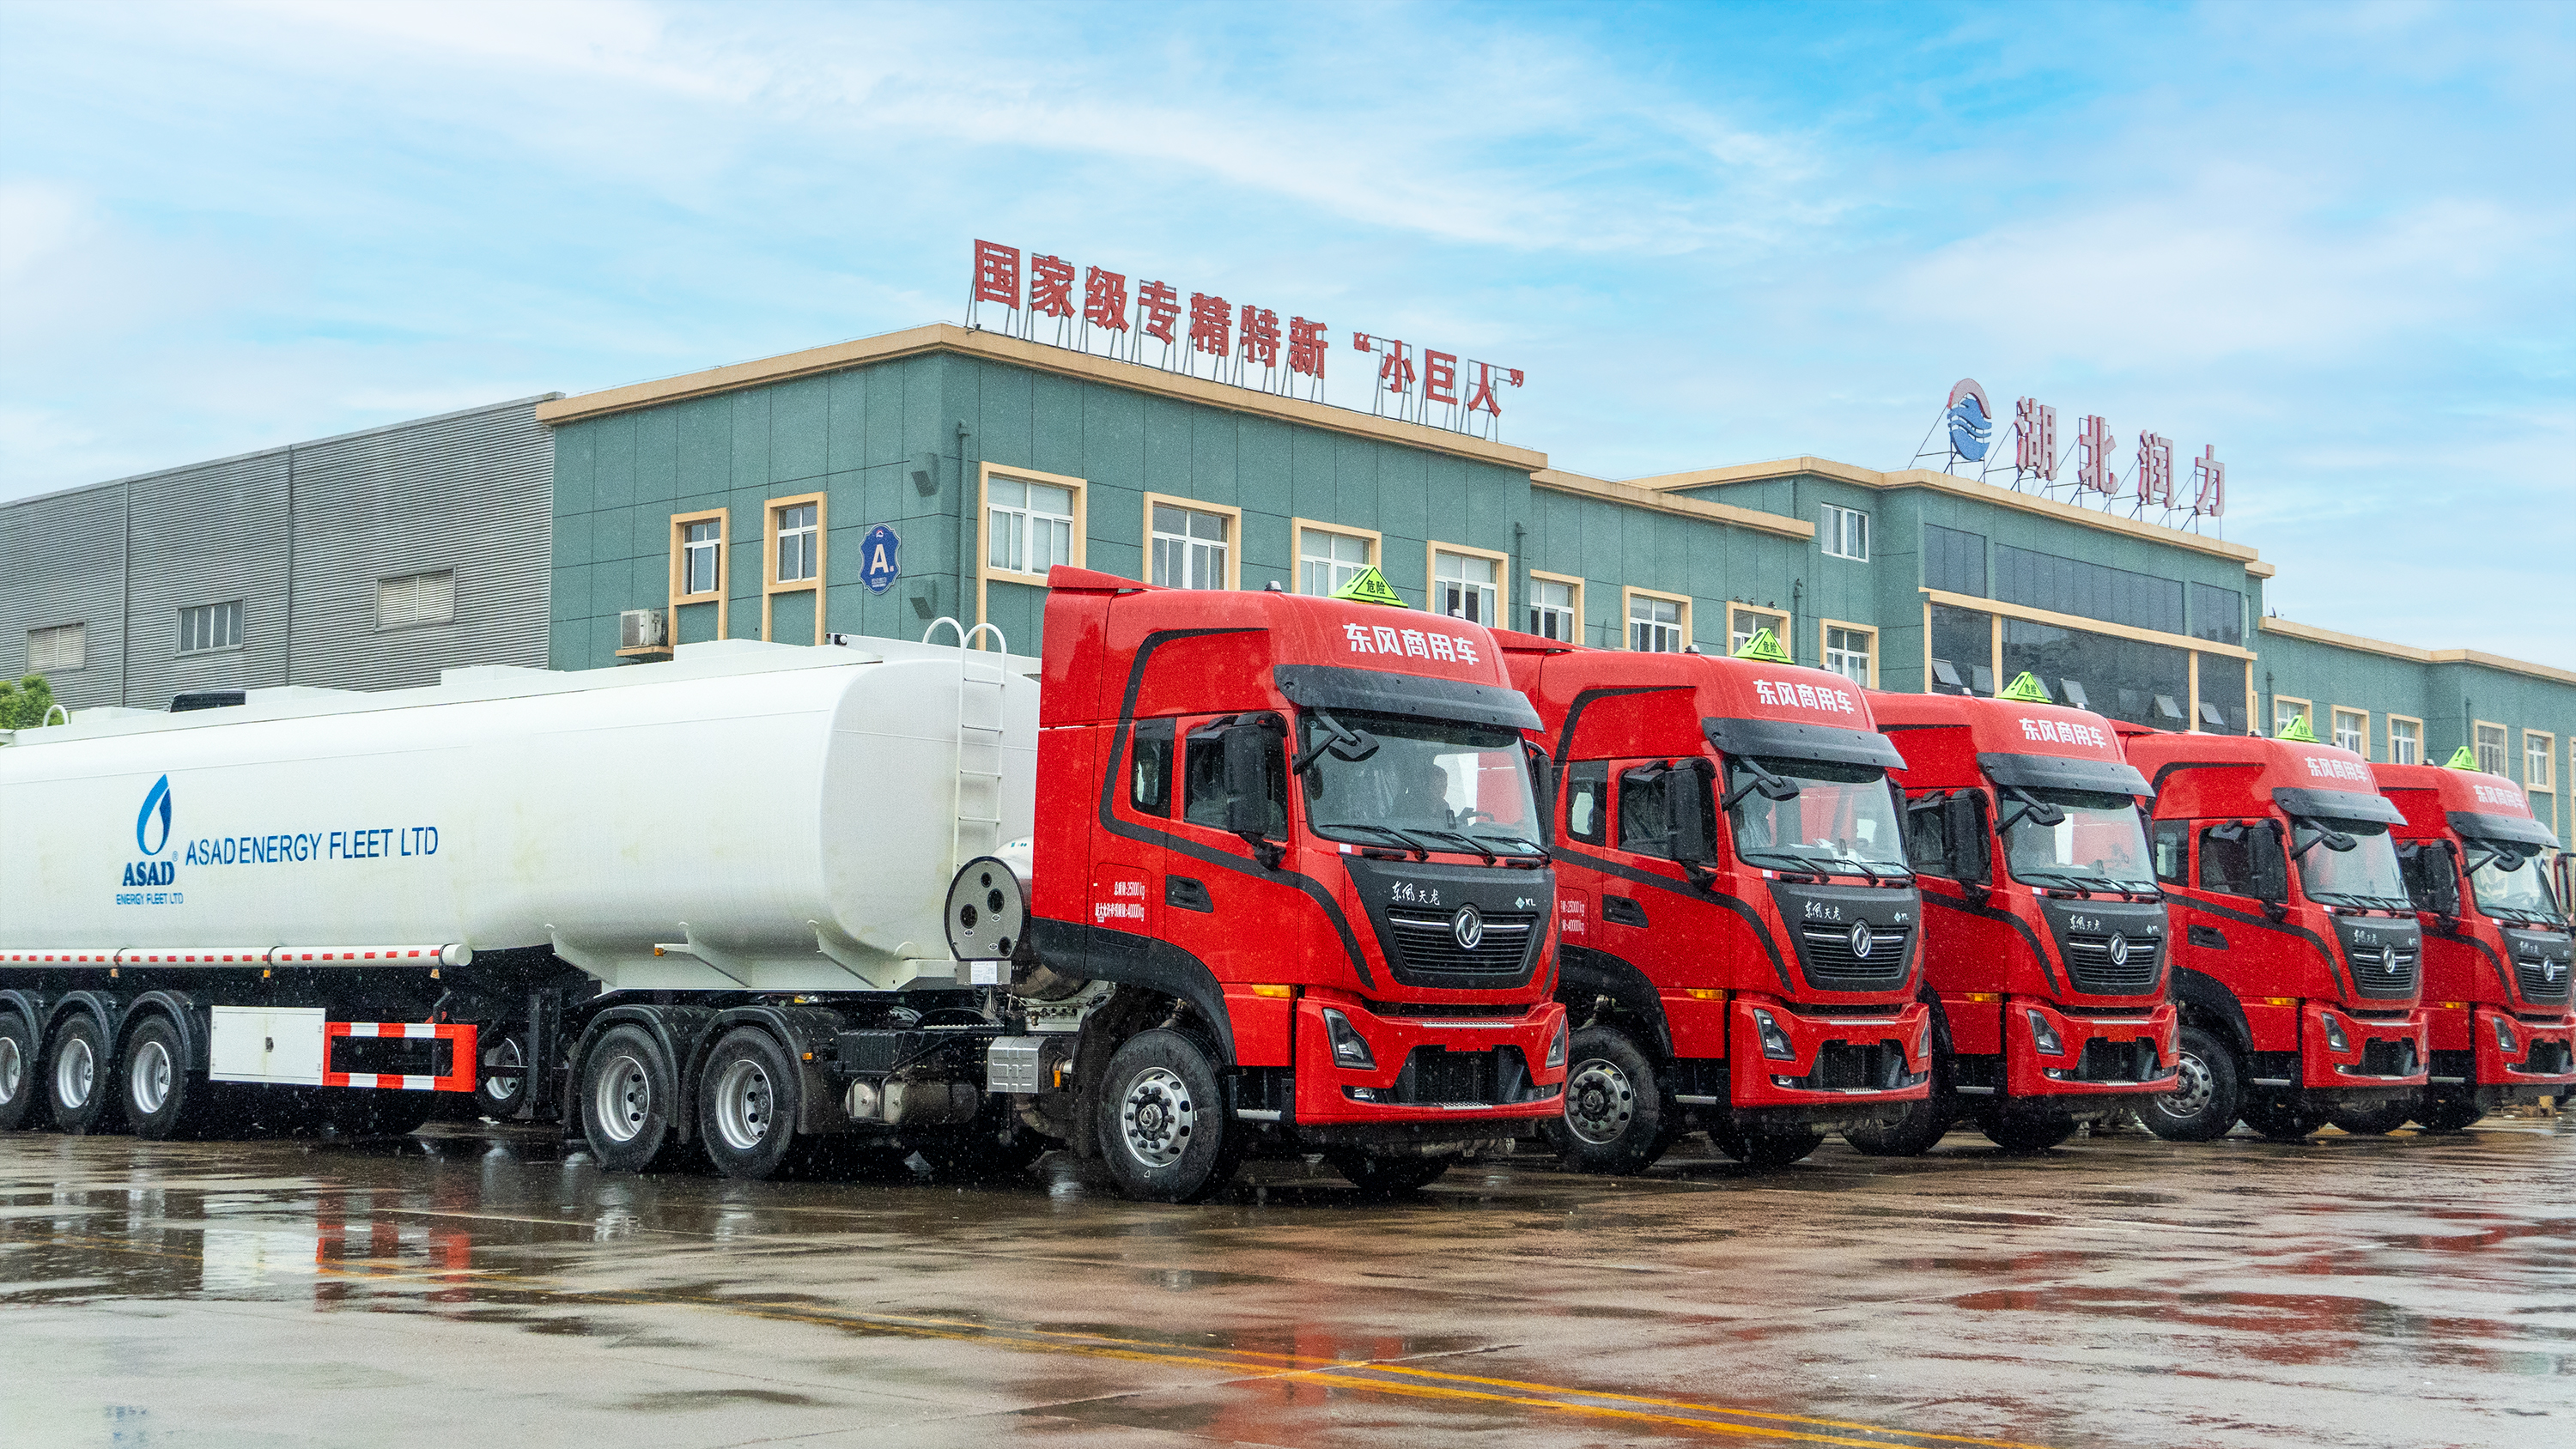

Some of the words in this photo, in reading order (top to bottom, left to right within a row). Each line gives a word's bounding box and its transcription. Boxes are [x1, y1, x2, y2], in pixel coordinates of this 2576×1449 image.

[2014, 396, 2226, 517] 湖北润力
[1365, 579, 1386, 595] 危险
[1342, 623, 1479, 665] 东风商用车
[1763, 640, 1777, 654] 危险
[1753, 679, 1855, 715] 东风商用车
[2019, 718, 2106, 749] 东风商用车
[2305, 756, 2367, 782] 东风商用车
[330, 828, 393, 859] FLEET
[401, 826, 439, 856] LTD
[122, 861, 175, 887] ASAD
[116, 893, 144, 905] ENERGY
[146, 893, 167, 905] FLEET
[170, 892, 184, 904] LTD
